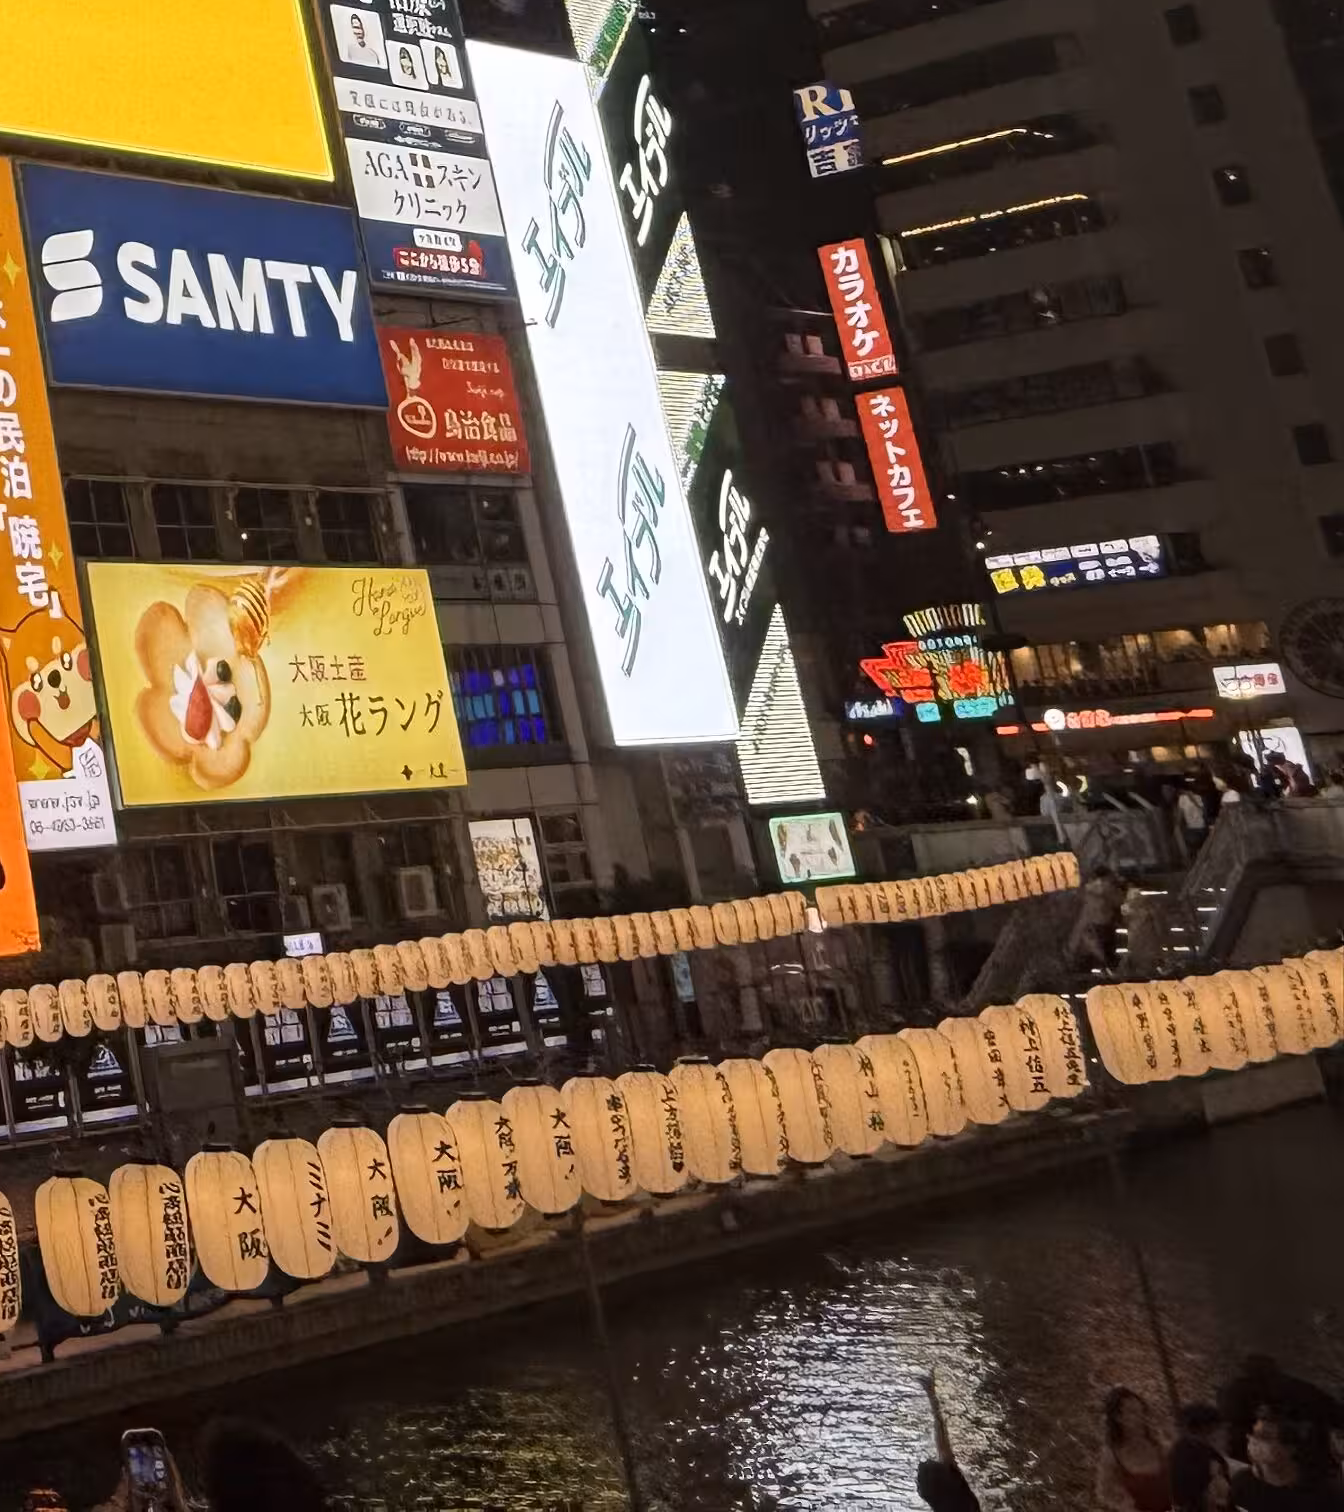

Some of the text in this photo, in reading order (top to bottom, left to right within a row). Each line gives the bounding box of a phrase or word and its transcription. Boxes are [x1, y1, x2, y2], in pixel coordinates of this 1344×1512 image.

[364, 150, 482, 193] AGA スキン
[393, 189, 468, 224] クリニック
[521, 99, 592, 329] エイブル
[119, 241, 361, 344] SAMTY
[830, 246, 880, 357] カラオケ
[869, 394, 925, 528] ネットカフェ
[596, 422, 666, 678] エイブル
[288, 654, 368, 683] 大阪土産
[232, 1187, 268, 1261] 大阪
[306, 1161, 333, 1252] ミナミ
